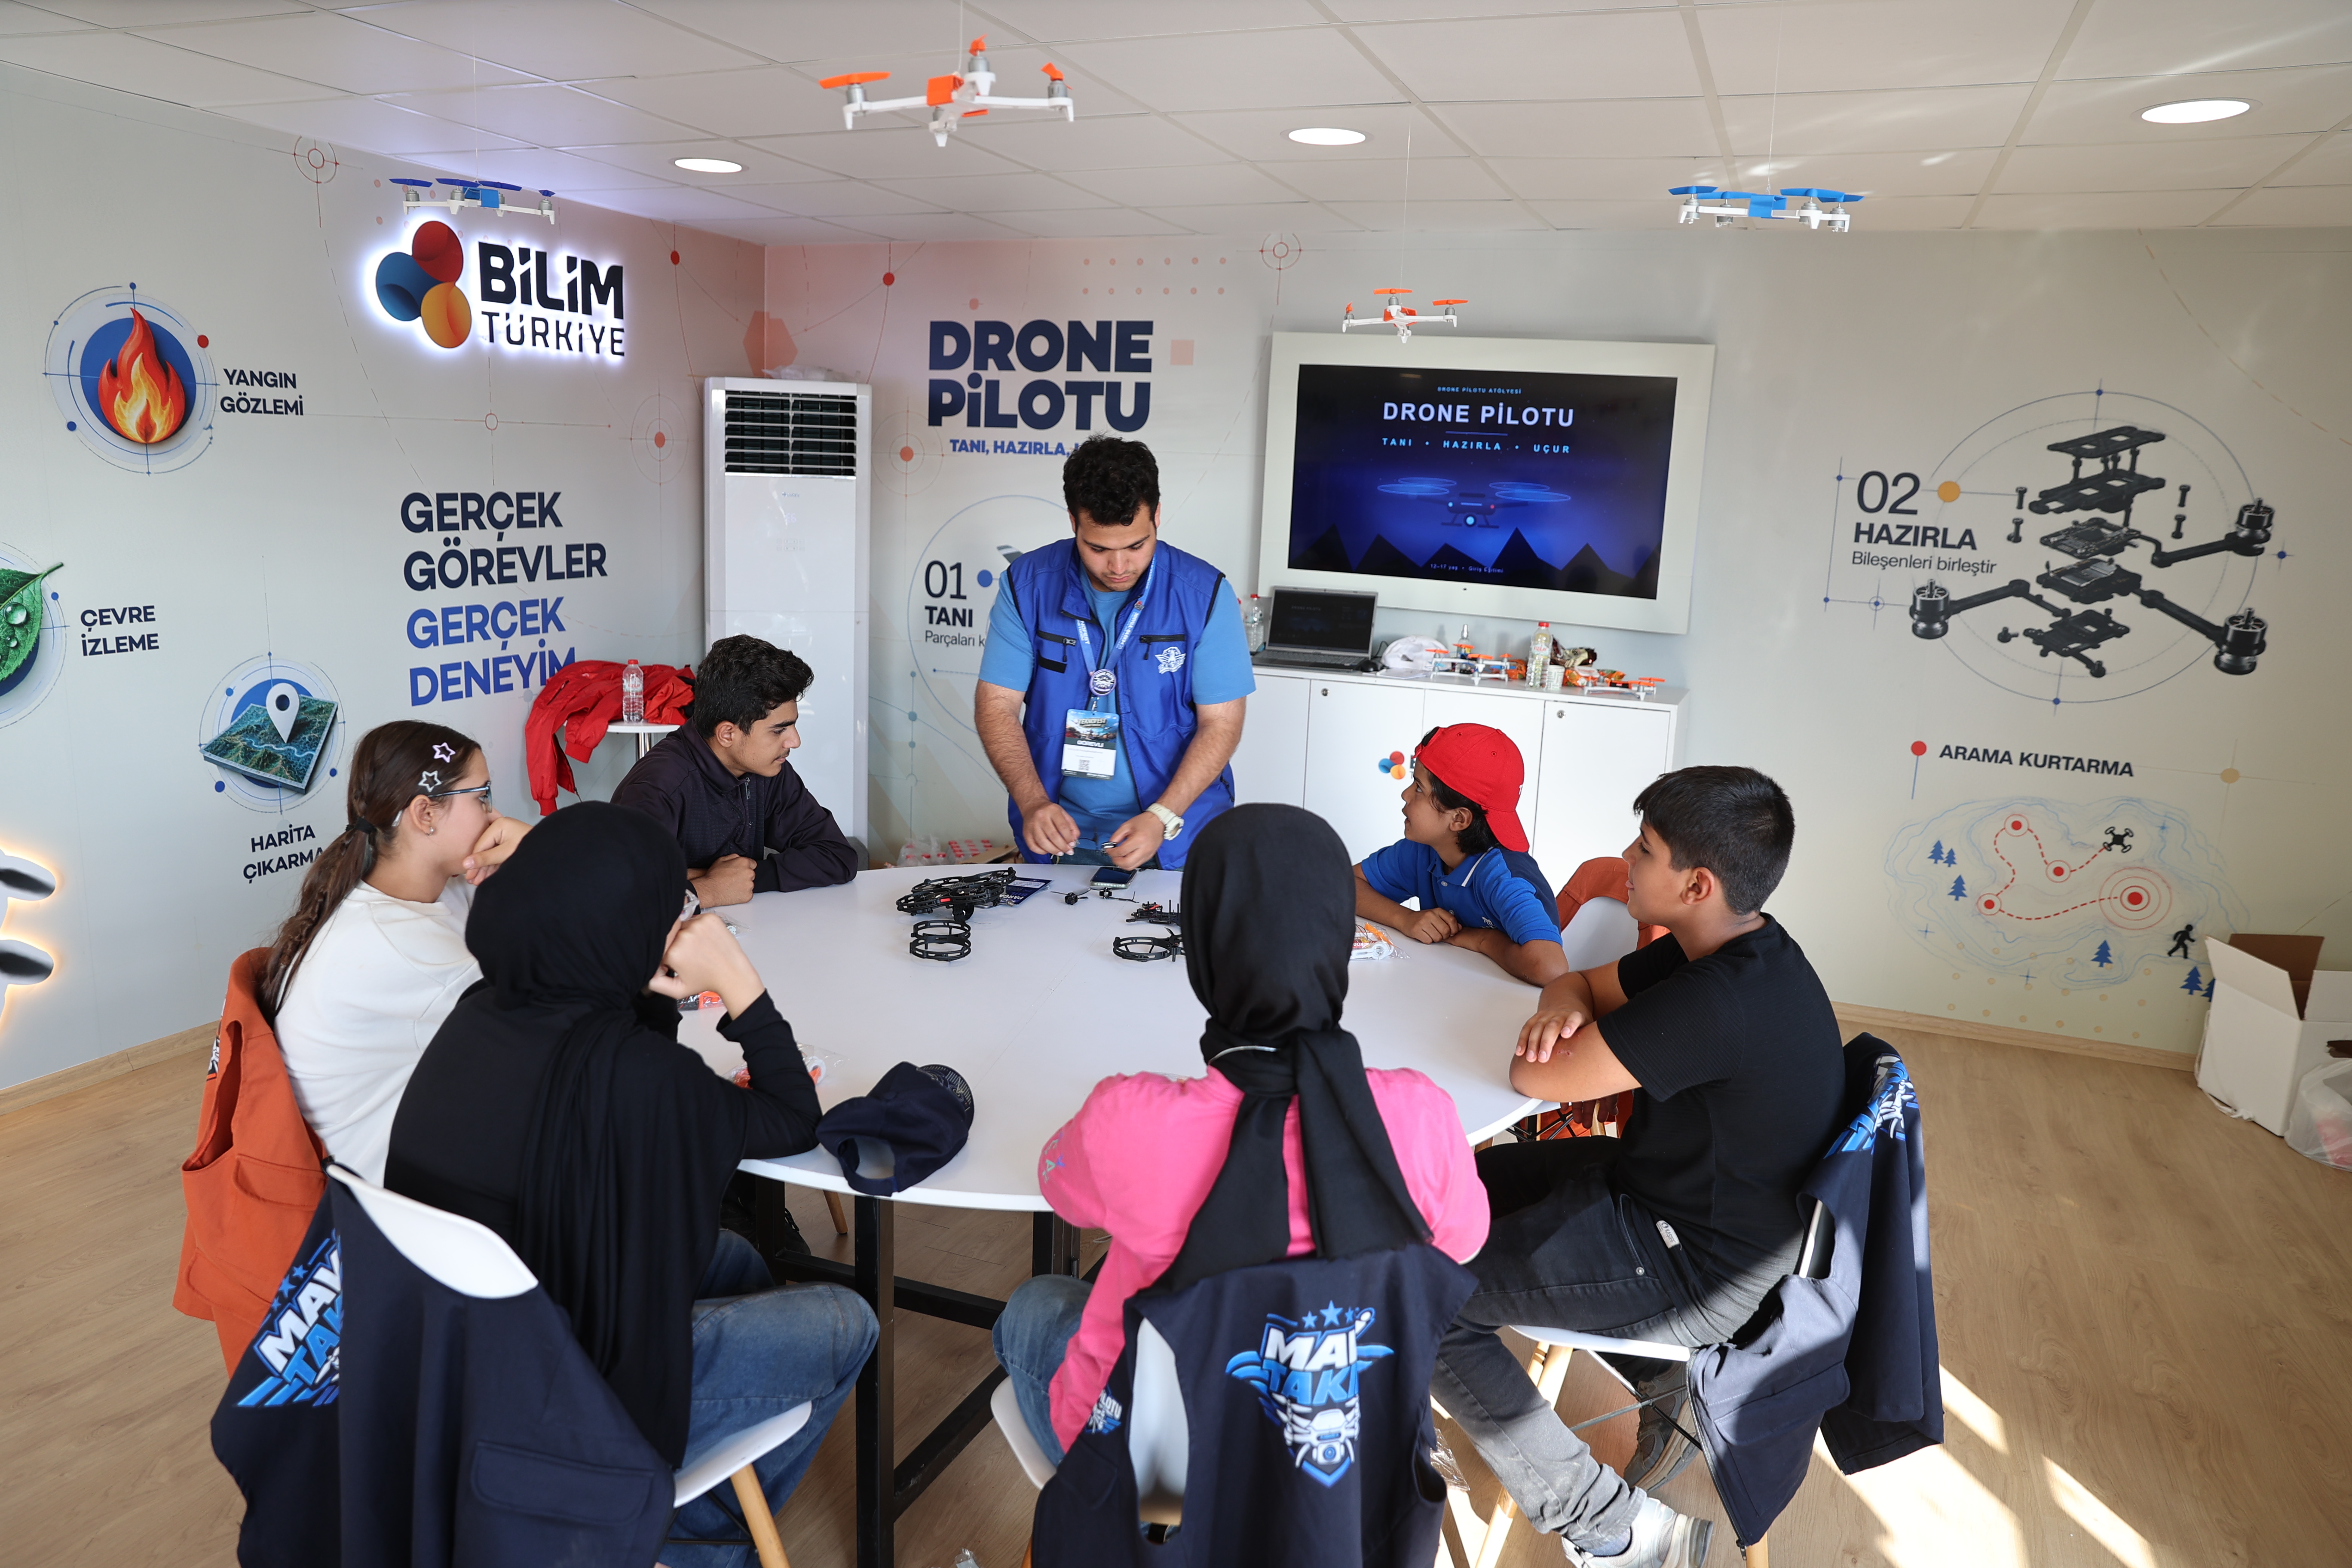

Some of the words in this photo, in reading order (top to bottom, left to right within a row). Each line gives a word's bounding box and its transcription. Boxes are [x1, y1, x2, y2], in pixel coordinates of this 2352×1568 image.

[478, 242, 624, 319] BİLİM
[481, 311, 625, 357] TÜRKİYE
[929, 319, 1154, 373] DRONE
[223, 368, 297, 389] YANGIN
[220, 393, 304, 416] GÖZLEMİ
[928, 372, 1151, 432] PİLOTU
[1383, 402, 1470, 423] DRONE
[1480, 402, 1574, 427] PİLOTU
[950, 439, 989, 456] TANI,
[993, 441, 1070, 457] HAZIRLA,
[1382, 438, 1412, 447] TANI
[1443, 440, 1501, 450] HAZIRLA
[1533, 444, 1570, 453] UÇUR
[1857, 471, 1920, 514] 02
[401, 492, 563, 541] GERÇEK
[1854, 522, 1977, 550] HAZIRLA
[404, 537, 608, 591] GÖREVLER
[1852, 551, 1933, 570] Bileşenleri
[1937, 556, 1997, 576] birleştir
[925, 560, 967, 600] 01
[80, 605, 156, 632] ÇEVRE
[406, 596, 566, 651] GERÇEK
[925, 605, 973, 628] TANI
[81, 633, 159, 656] İZLEME
[925, 630, 975, 647] Parçaları
[410, 638, 576, 707] DENEYİM
[1939, 744, 2013, 765] ARAMA
[2018, 752, 2135, 777] KURTARMA
[251, 824, 315, 852] HARİTA
